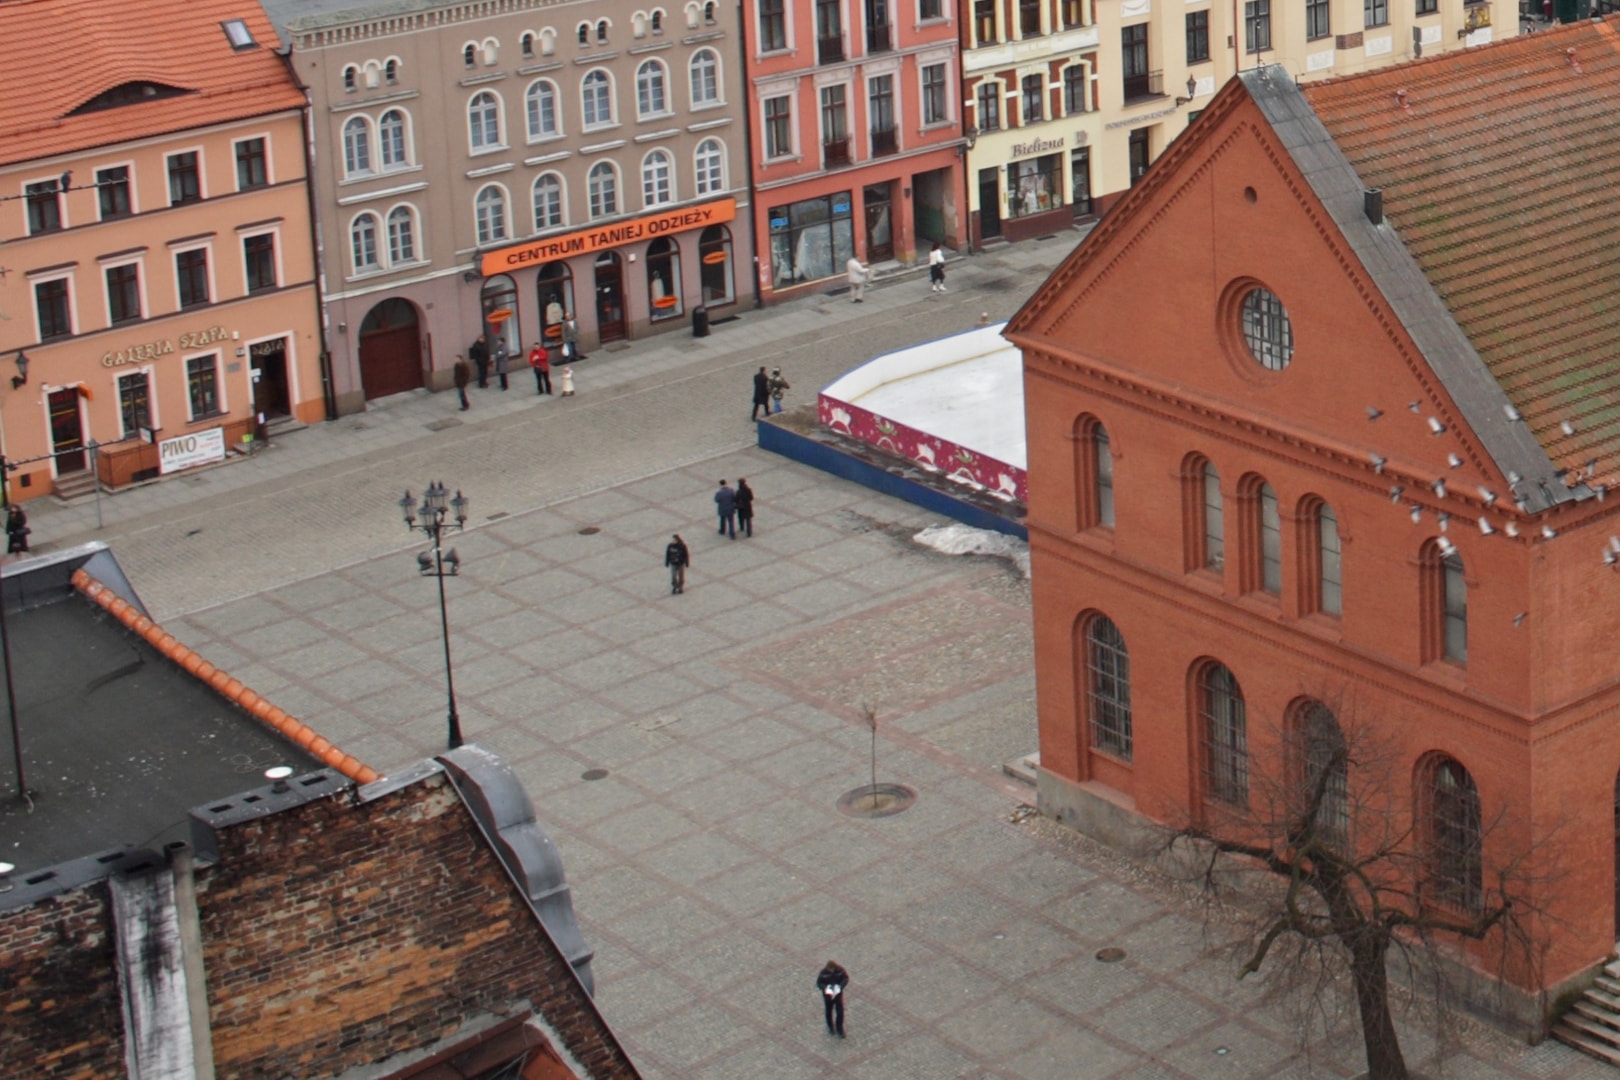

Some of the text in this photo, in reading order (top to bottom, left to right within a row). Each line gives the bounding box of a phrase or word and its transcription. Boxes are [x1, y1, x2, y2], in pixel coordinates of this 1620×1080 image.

[1012, 136, 1065, 158] Bielizna
[506, 209, 713, 265] CENTRUM TANIEJ ODZIEŻY
[102, 326, 229, 367] GALERIA SZAFA
[162, 436, 197, 459] PIWO
